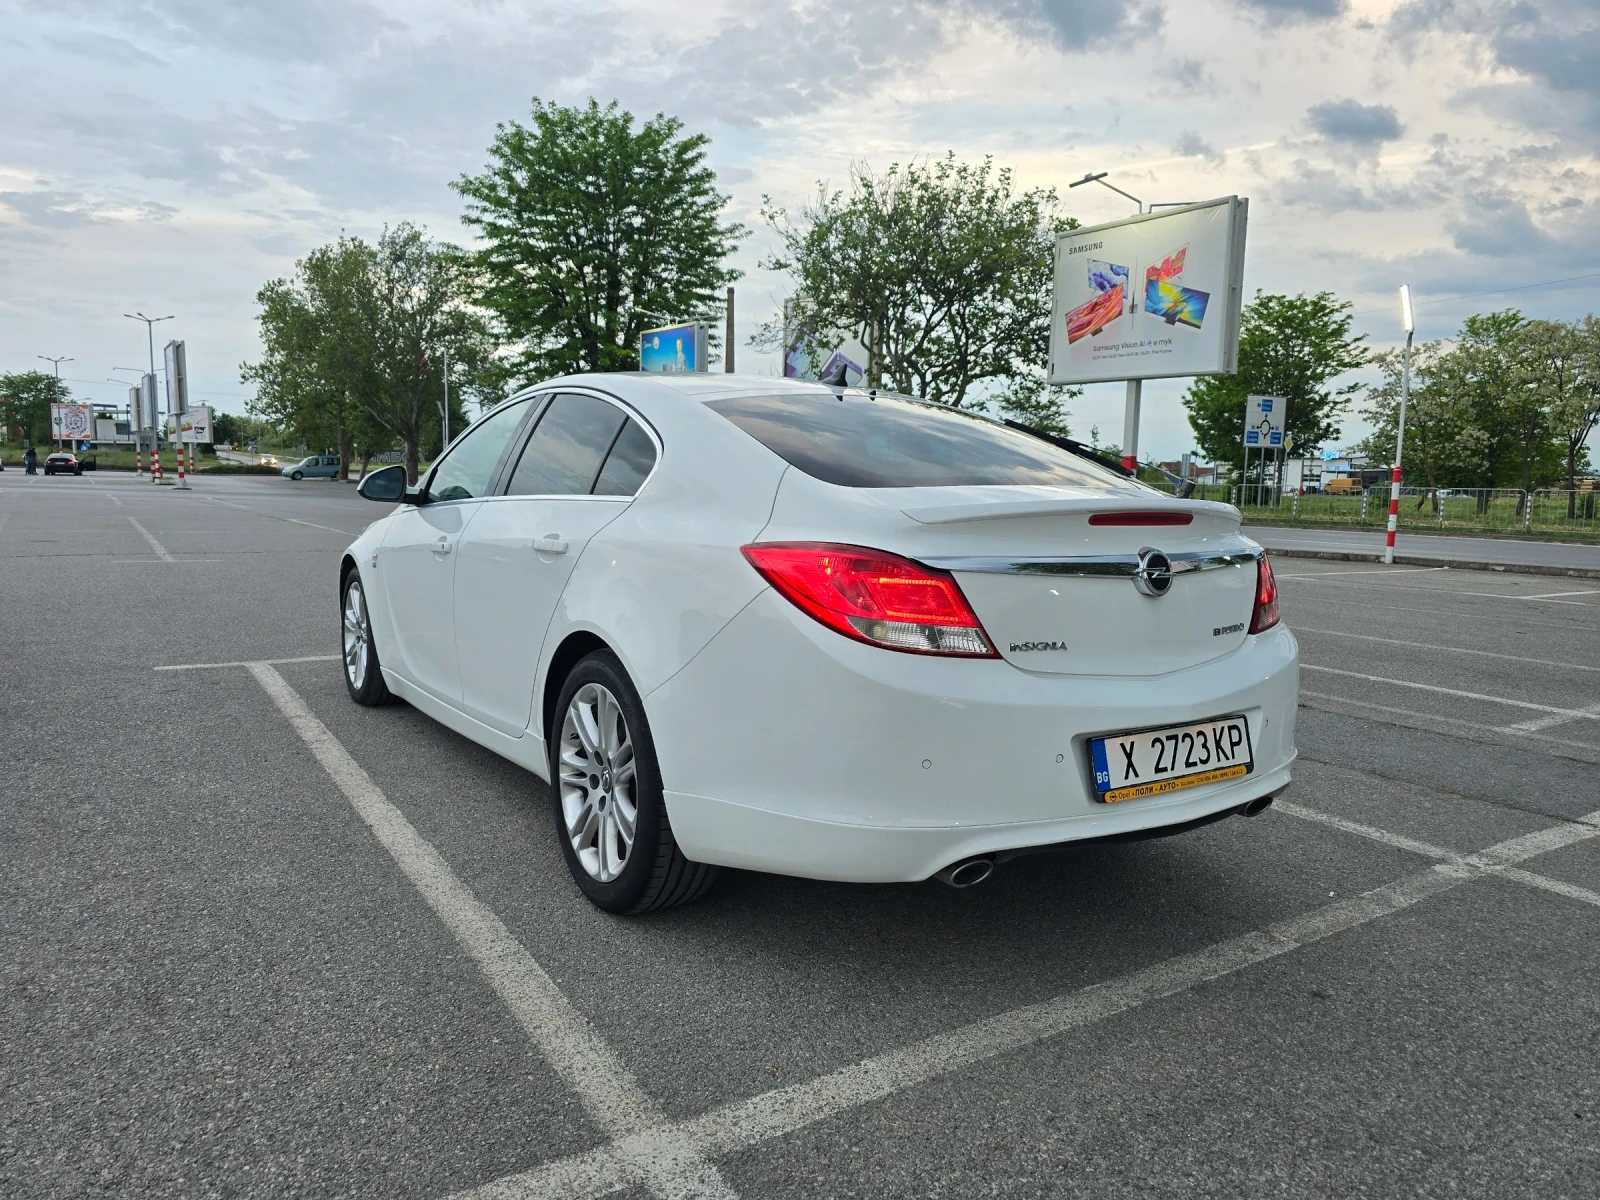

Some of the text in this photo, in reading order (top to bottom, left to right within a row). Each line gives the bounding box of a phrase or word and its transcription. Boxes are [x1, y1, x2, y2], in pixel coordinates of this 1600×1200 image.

[1069, 242, 1103, 255] SAMSUNG
[1092, 343, 1120, 352] Samsung
[1121, 341, 1138, 349] Vision
[1009, 641, 1068, 652] INSIGNIA
[1096, 771, 1109, 784] BG
[1118, 790, 1131, 800] Opel
[1135, 786, 1154, 797] ПОЛИ
[1158, 781, 1176, 792] АУТО
